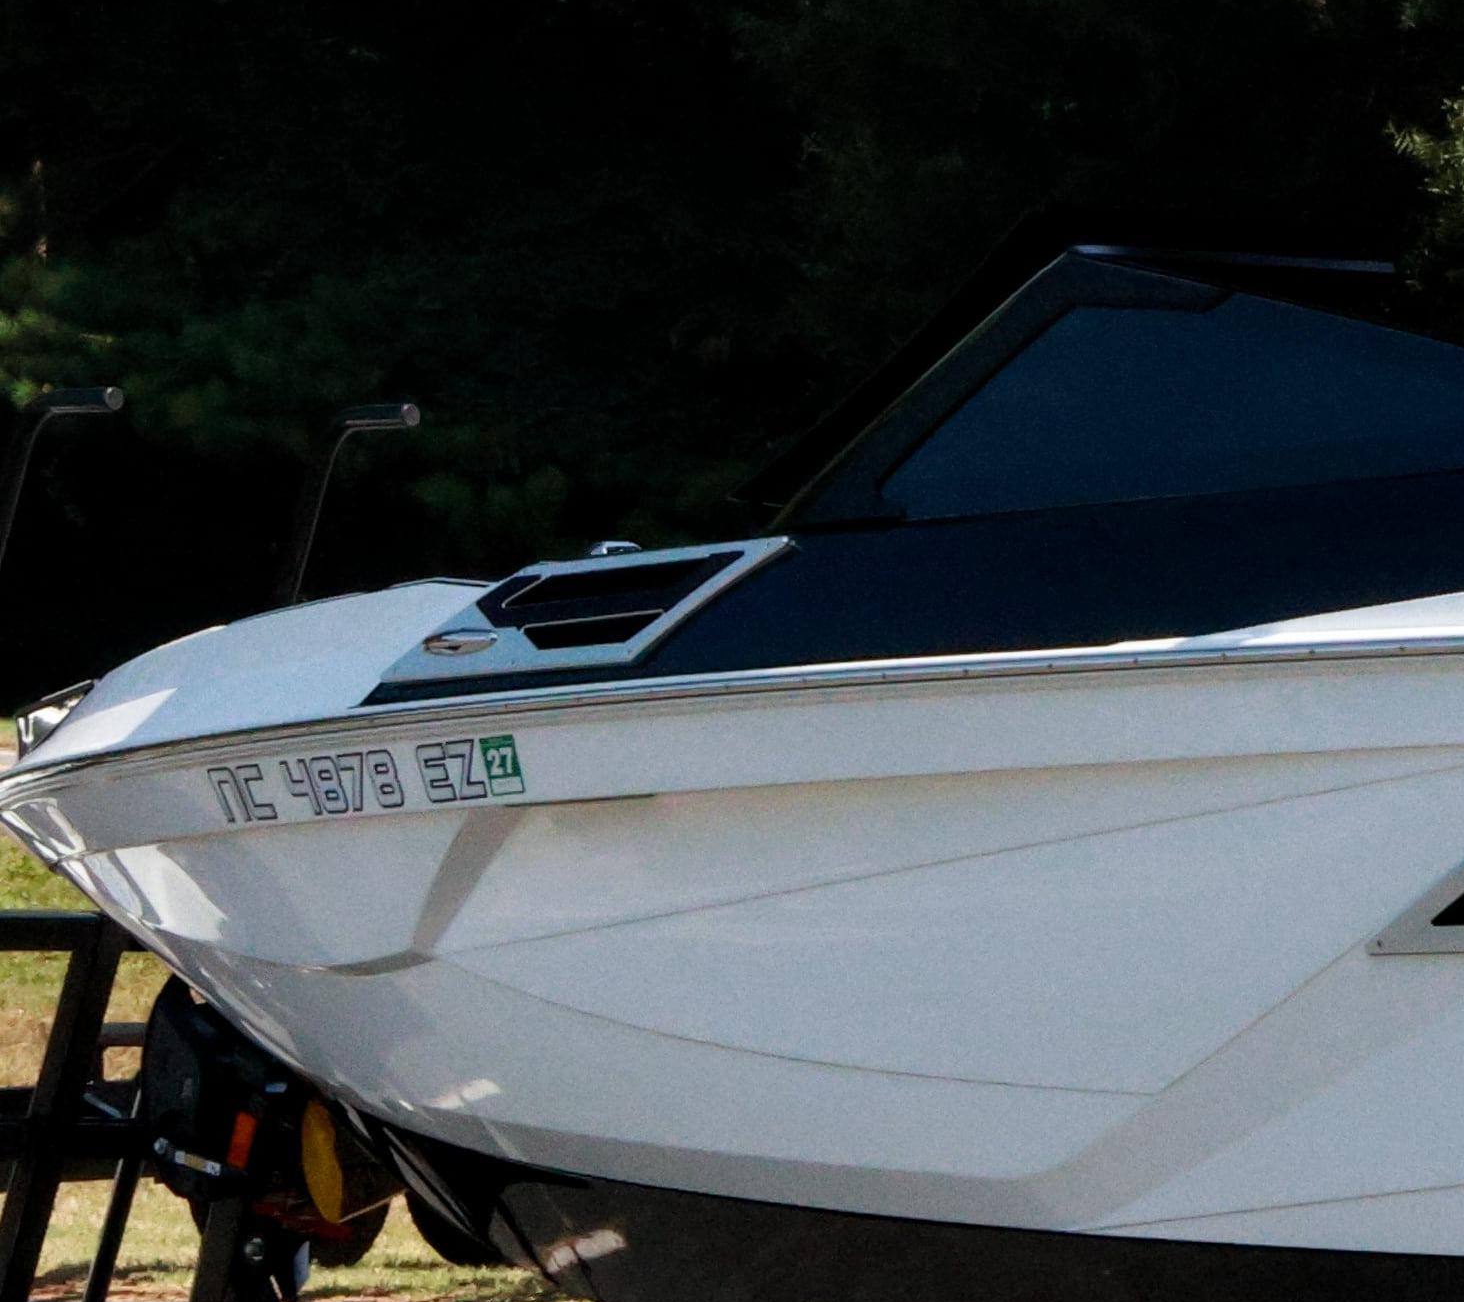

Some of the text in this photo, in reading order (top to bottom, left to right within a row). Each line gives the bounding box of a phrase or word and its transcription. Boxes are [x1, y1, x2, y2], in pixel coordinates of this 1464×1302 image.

[207, 738, 488, 823] NC 4878 EZ
[486, 746, 514, 776] 27
